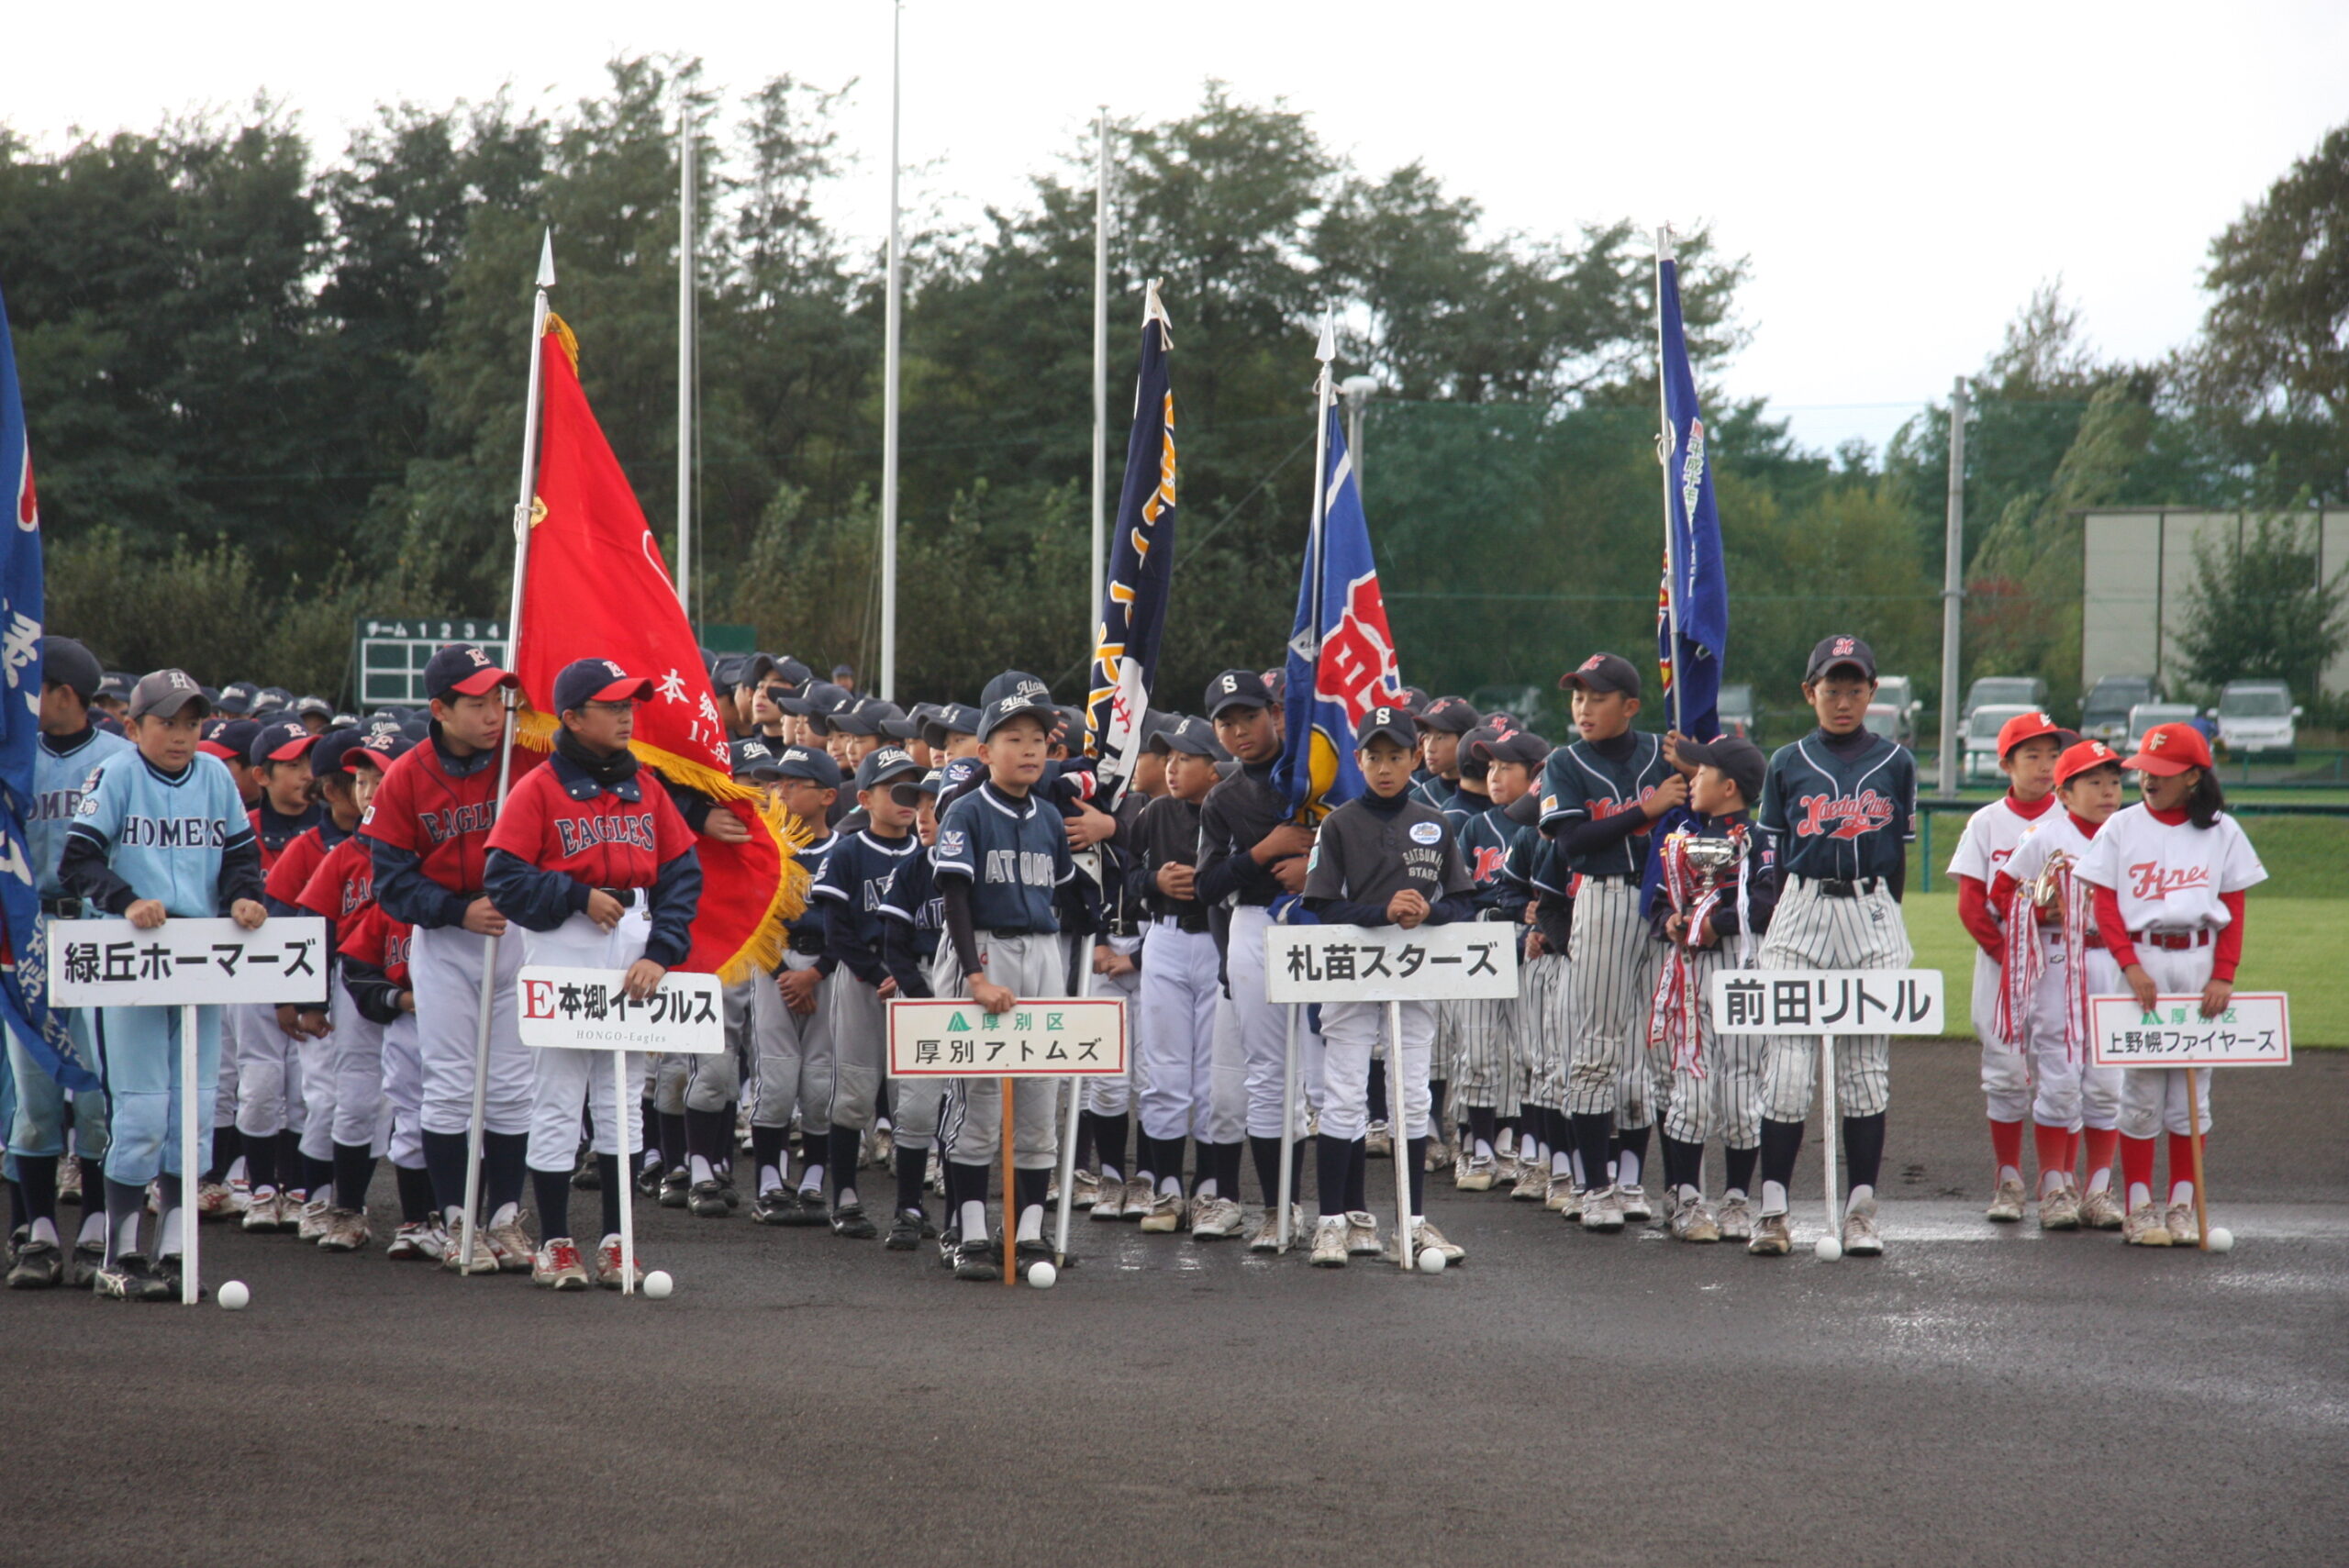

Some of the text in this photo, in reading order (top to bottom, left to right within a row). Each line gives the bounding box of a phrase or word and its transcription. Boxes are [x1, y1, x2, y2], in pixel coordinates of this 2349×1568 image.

[418, 623, 428, 639] 1
[440, 622, 452, 639] 2
[464, 622, 476, 639] 3
[487, 623, 499, 639] 4
[465, 648, 491, 667] E
[168, 672, 192, 689] H
[1222, 674, 1238, 694] S
[1375, 706, 1391, 725] S
[2149, 733, 2168, 751] F
[554, 812, 655, 859] EAGLES
[63, 939, 317, 984] 緑丘ホーマーズ
[1286, 940, 1498, 983] 札苗スターズ
[522, 979, 718, 1025] E 本郷イーグルス
[1724, 977, 1932, 1028] 前田リトル
[981, 1012, 1064, 1031] 厚別区
[576, 1029, 667, 1044] HONGO-Eagles
[2106, 1029, 2276, 1054] 上野幌ファイヤーズ
[915, 1037, 1103, 1065] 厚別アトムズ
